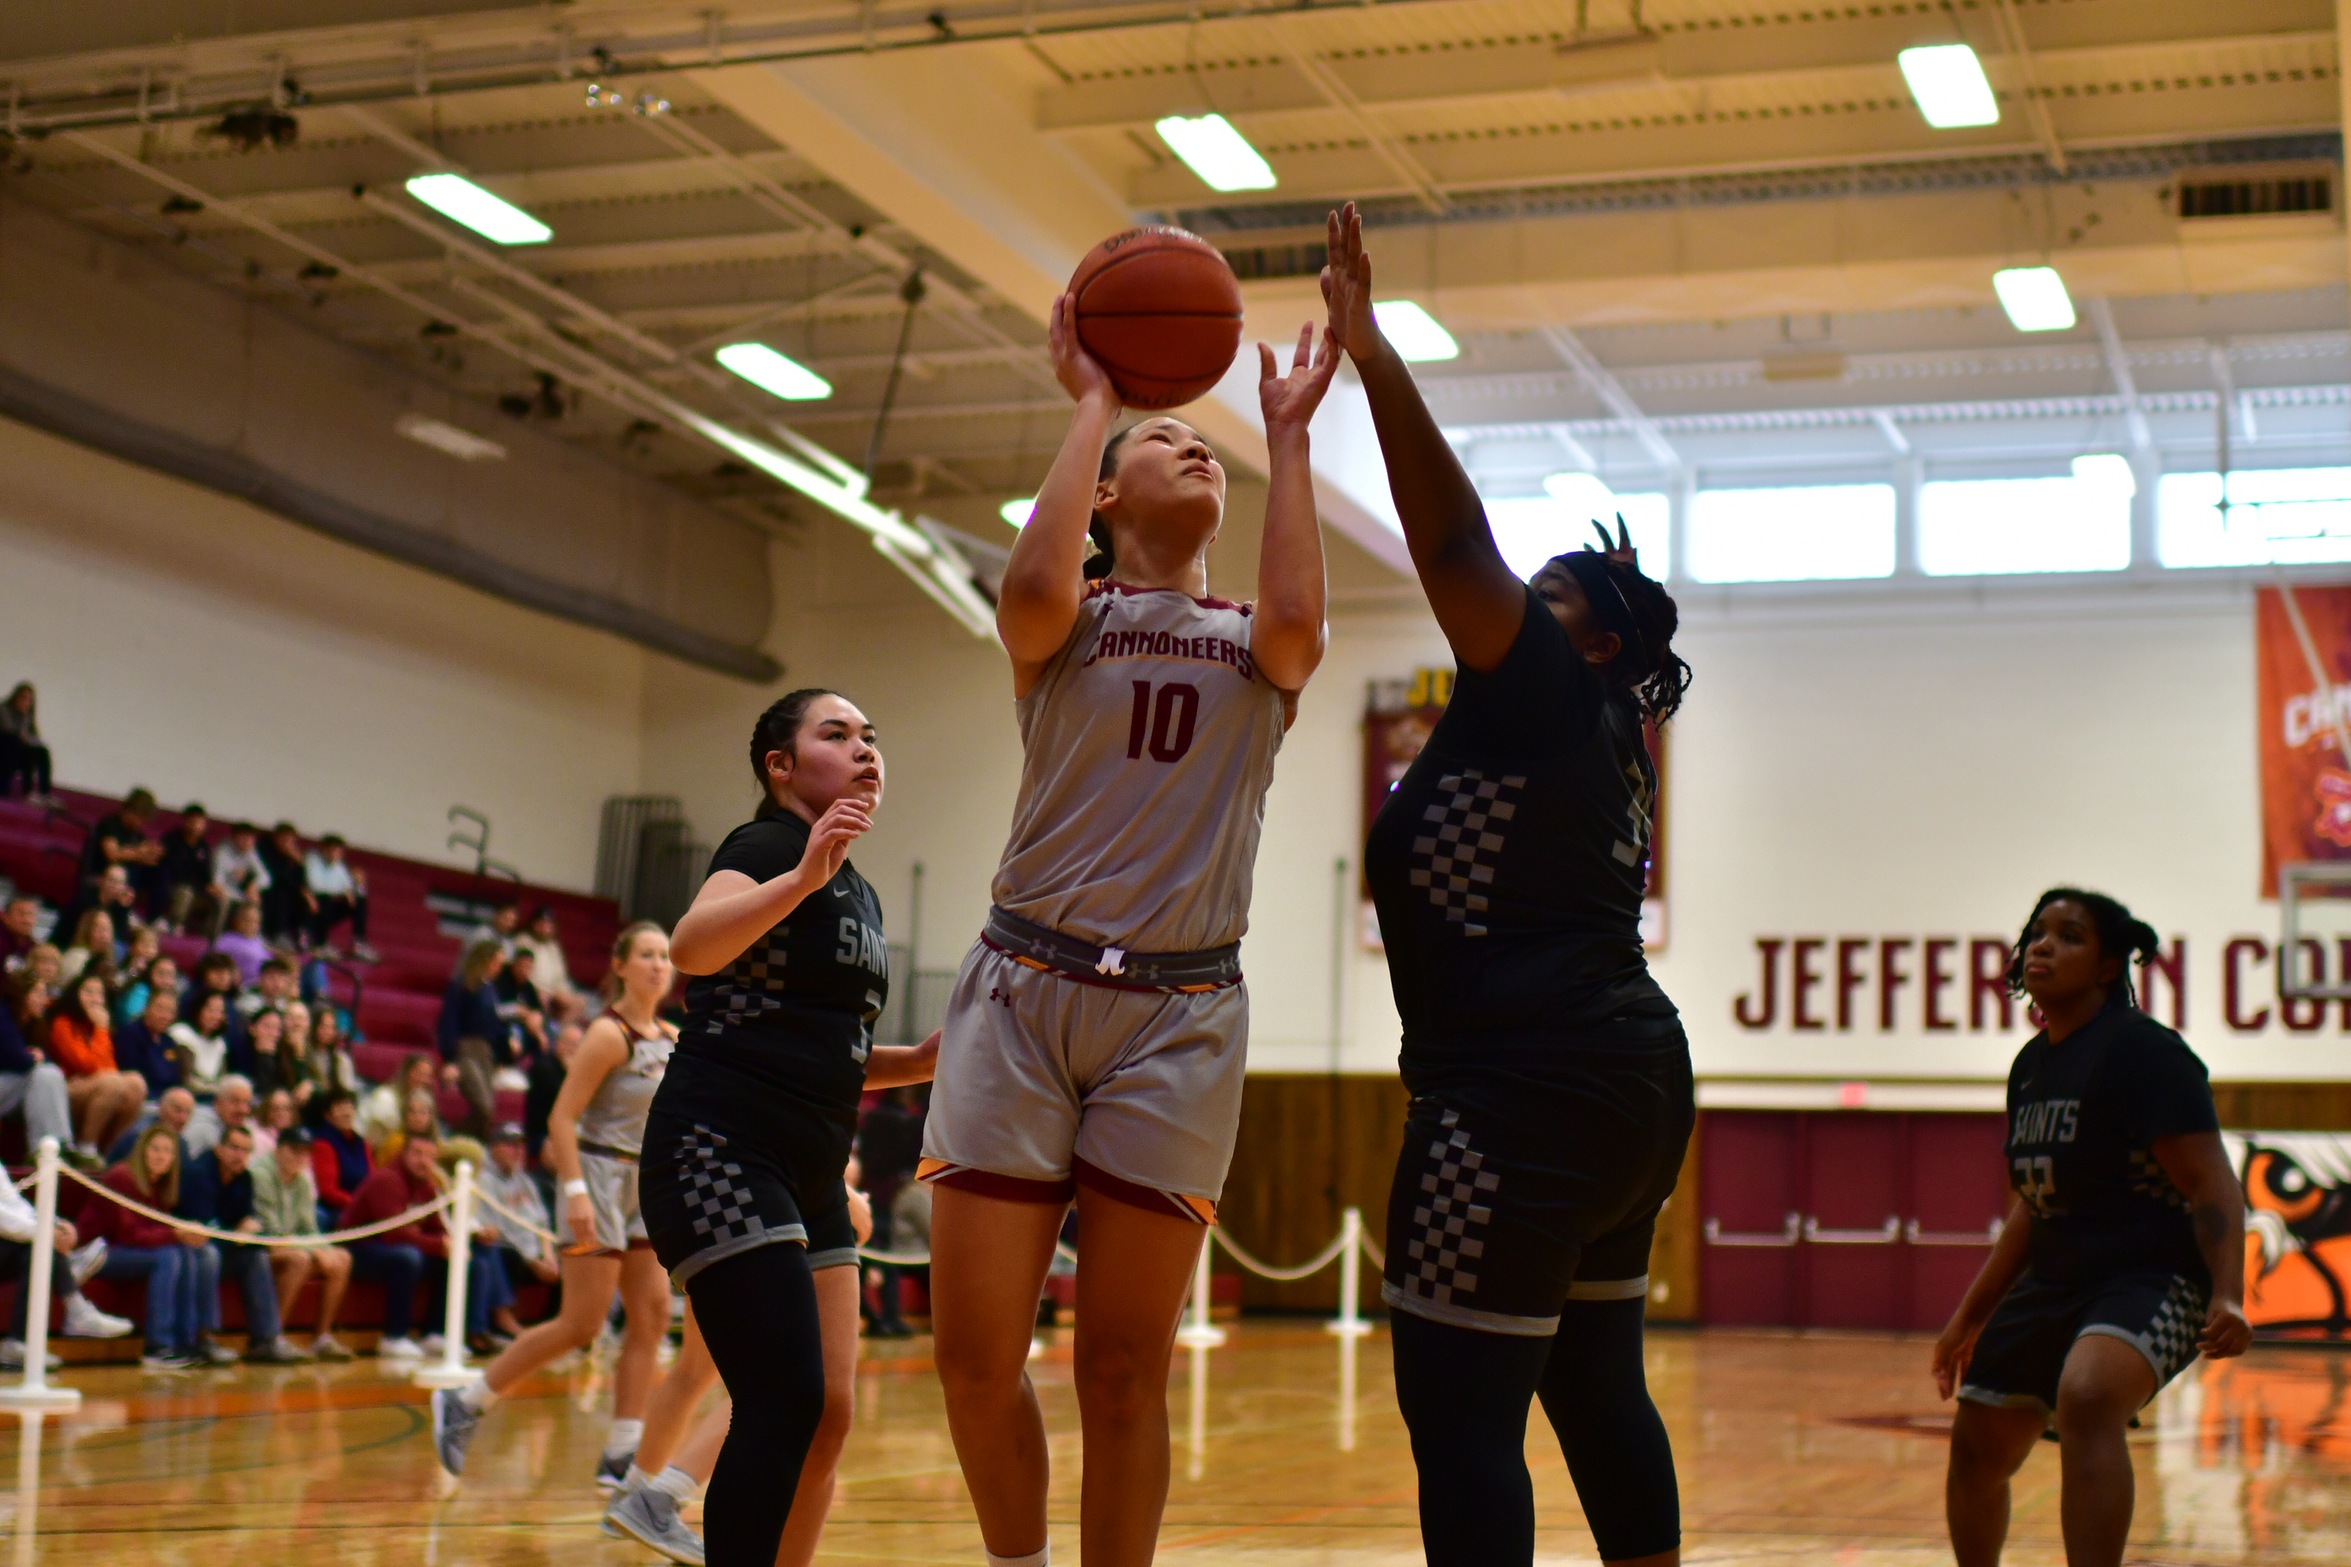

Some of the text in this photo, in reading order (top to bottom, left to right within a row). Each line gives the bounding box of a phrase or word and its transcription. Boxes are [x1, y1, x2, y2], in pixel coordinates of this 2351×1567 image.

[1127, 680, 1200, 763] 10
[836, 916, 888, 981] SAIN
[1734, 936, 2185, 1031] JEFFERN
